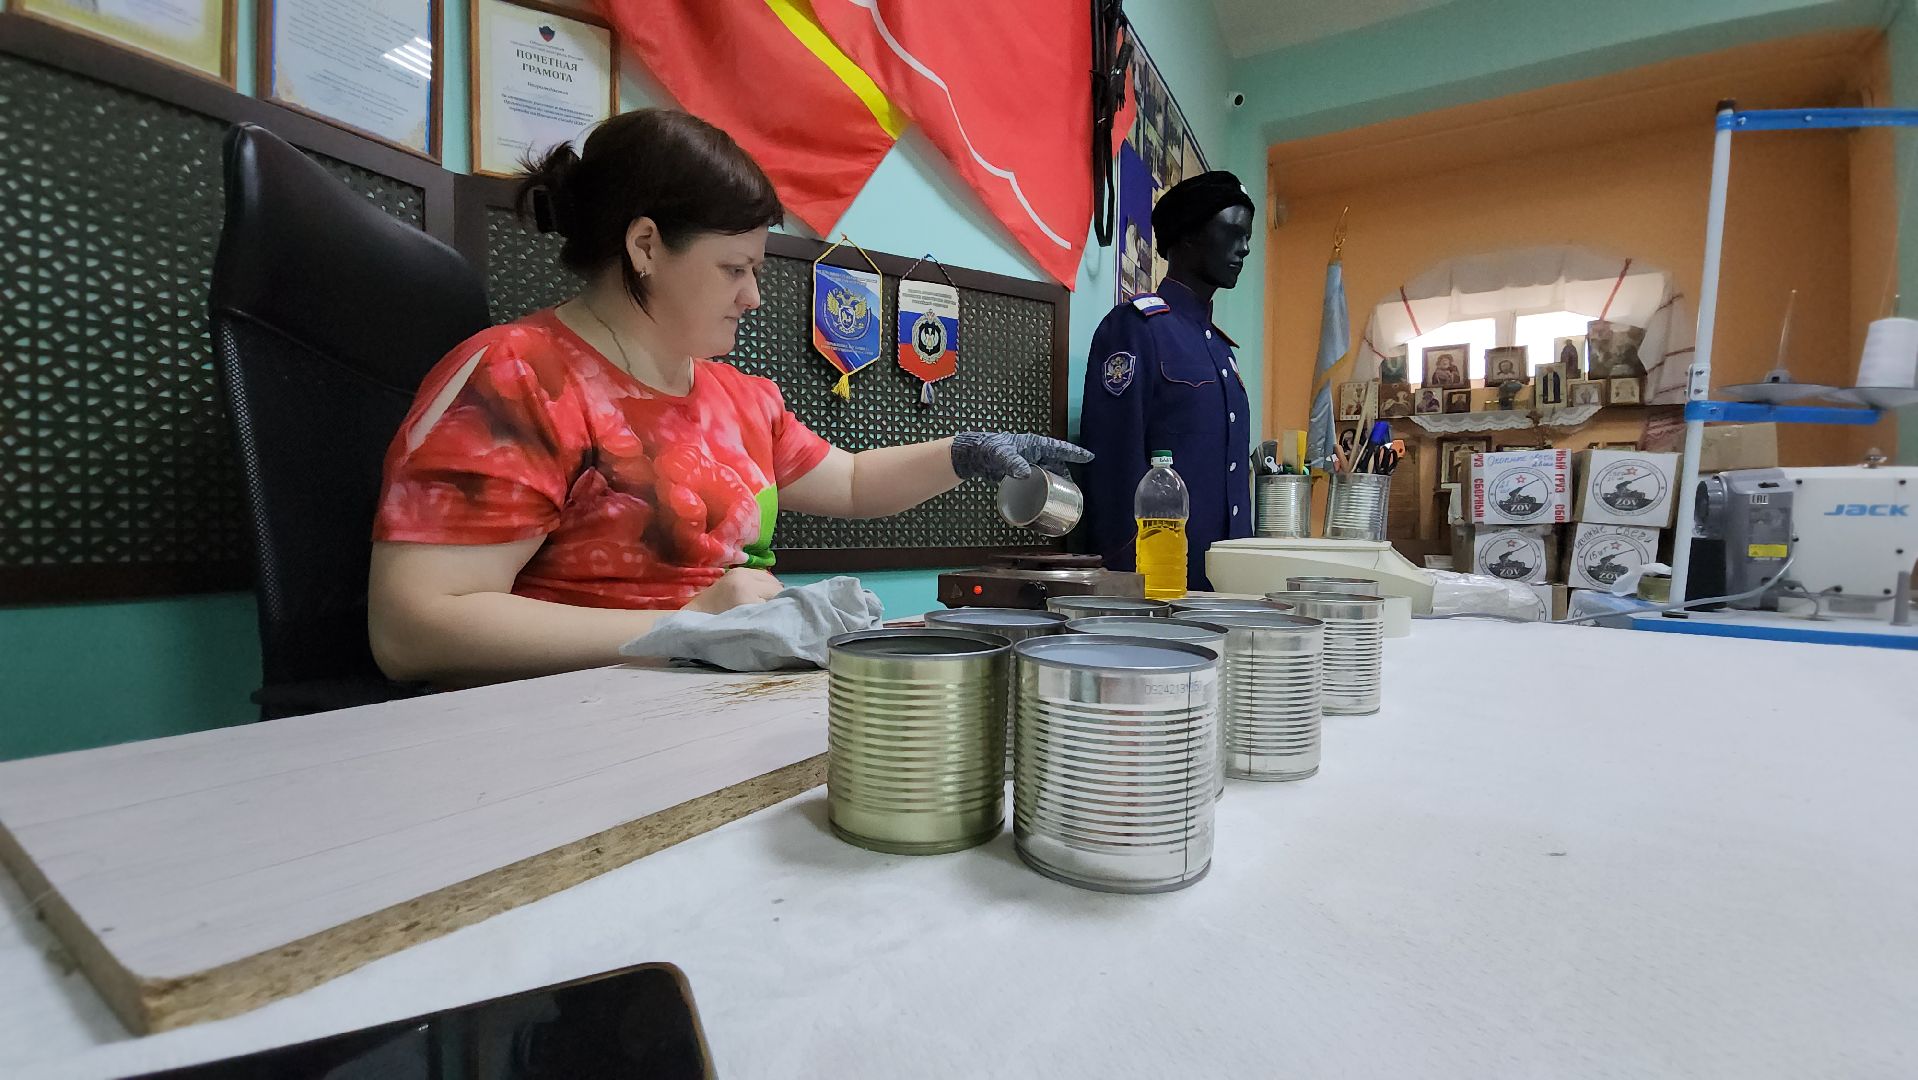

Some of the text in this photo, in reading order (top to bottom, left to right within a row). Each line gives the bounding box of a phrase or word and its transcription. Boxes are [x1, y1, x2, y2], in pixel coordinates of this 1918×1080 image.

[516, 48, 578, 72] ПОЧЕТНАЯ
[522, 62, 573, 83] ГРАМОТА
[1554, 474, 1565, 493] ГРУЗ
[1473, 478, 1486, 518] СБОРНЫЙ
[1615, 498, 1638, 506] ZOV
[1554, 504, 1565, 523] СБО
